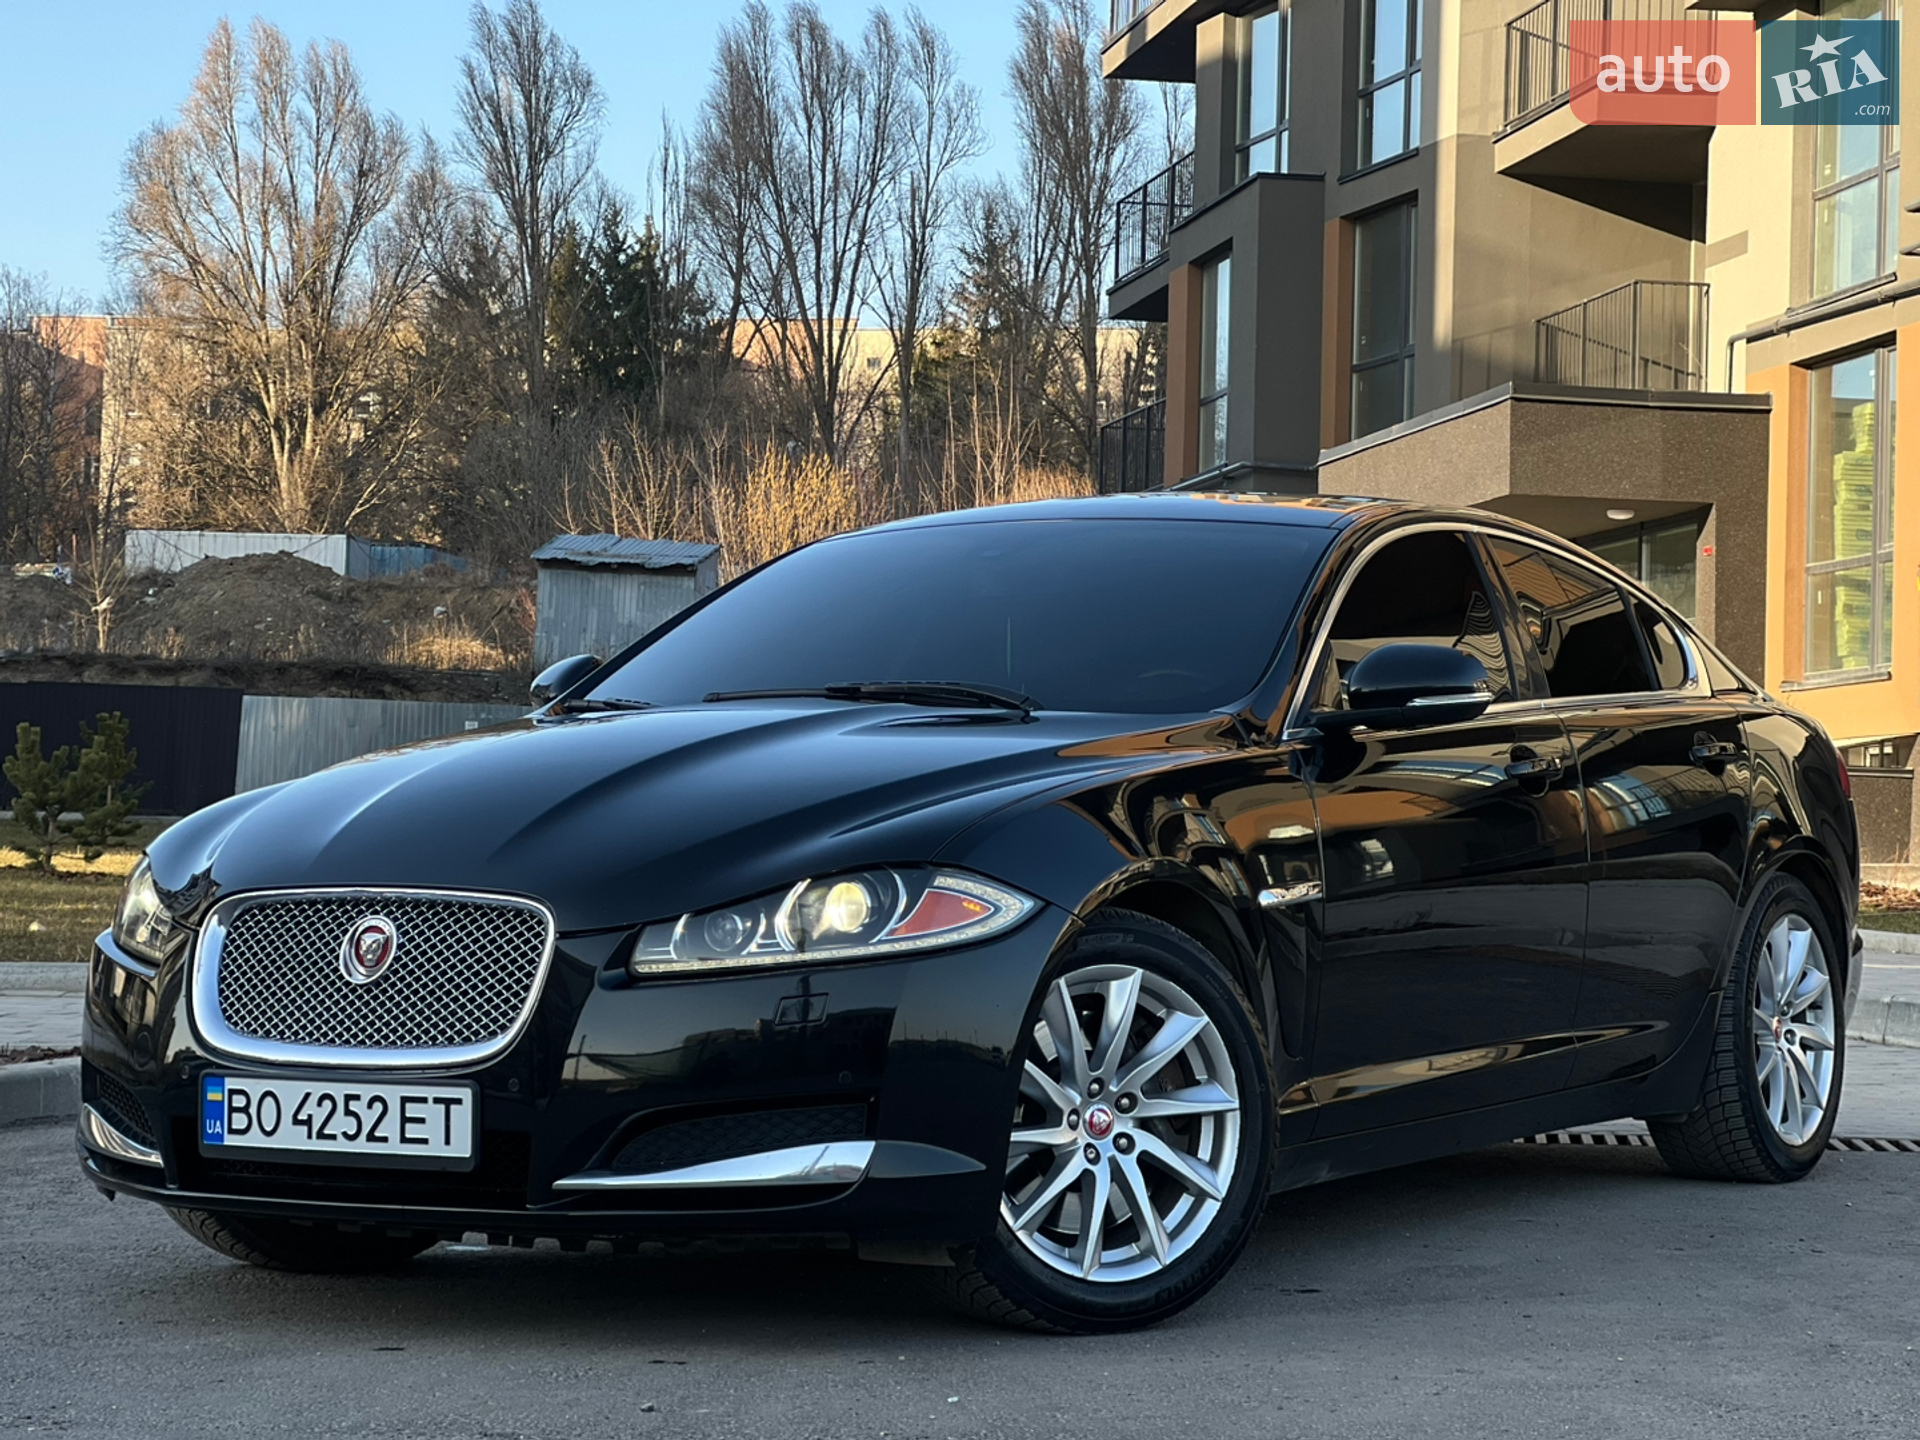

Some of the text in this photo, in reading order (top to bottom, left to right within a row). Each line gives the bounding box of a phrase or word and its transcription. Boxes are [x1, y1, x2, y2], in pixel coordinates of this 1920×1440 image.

[206, 1119, 222, 1135] UA
[227, 1087, 464, 1147] BO 4252 ET
